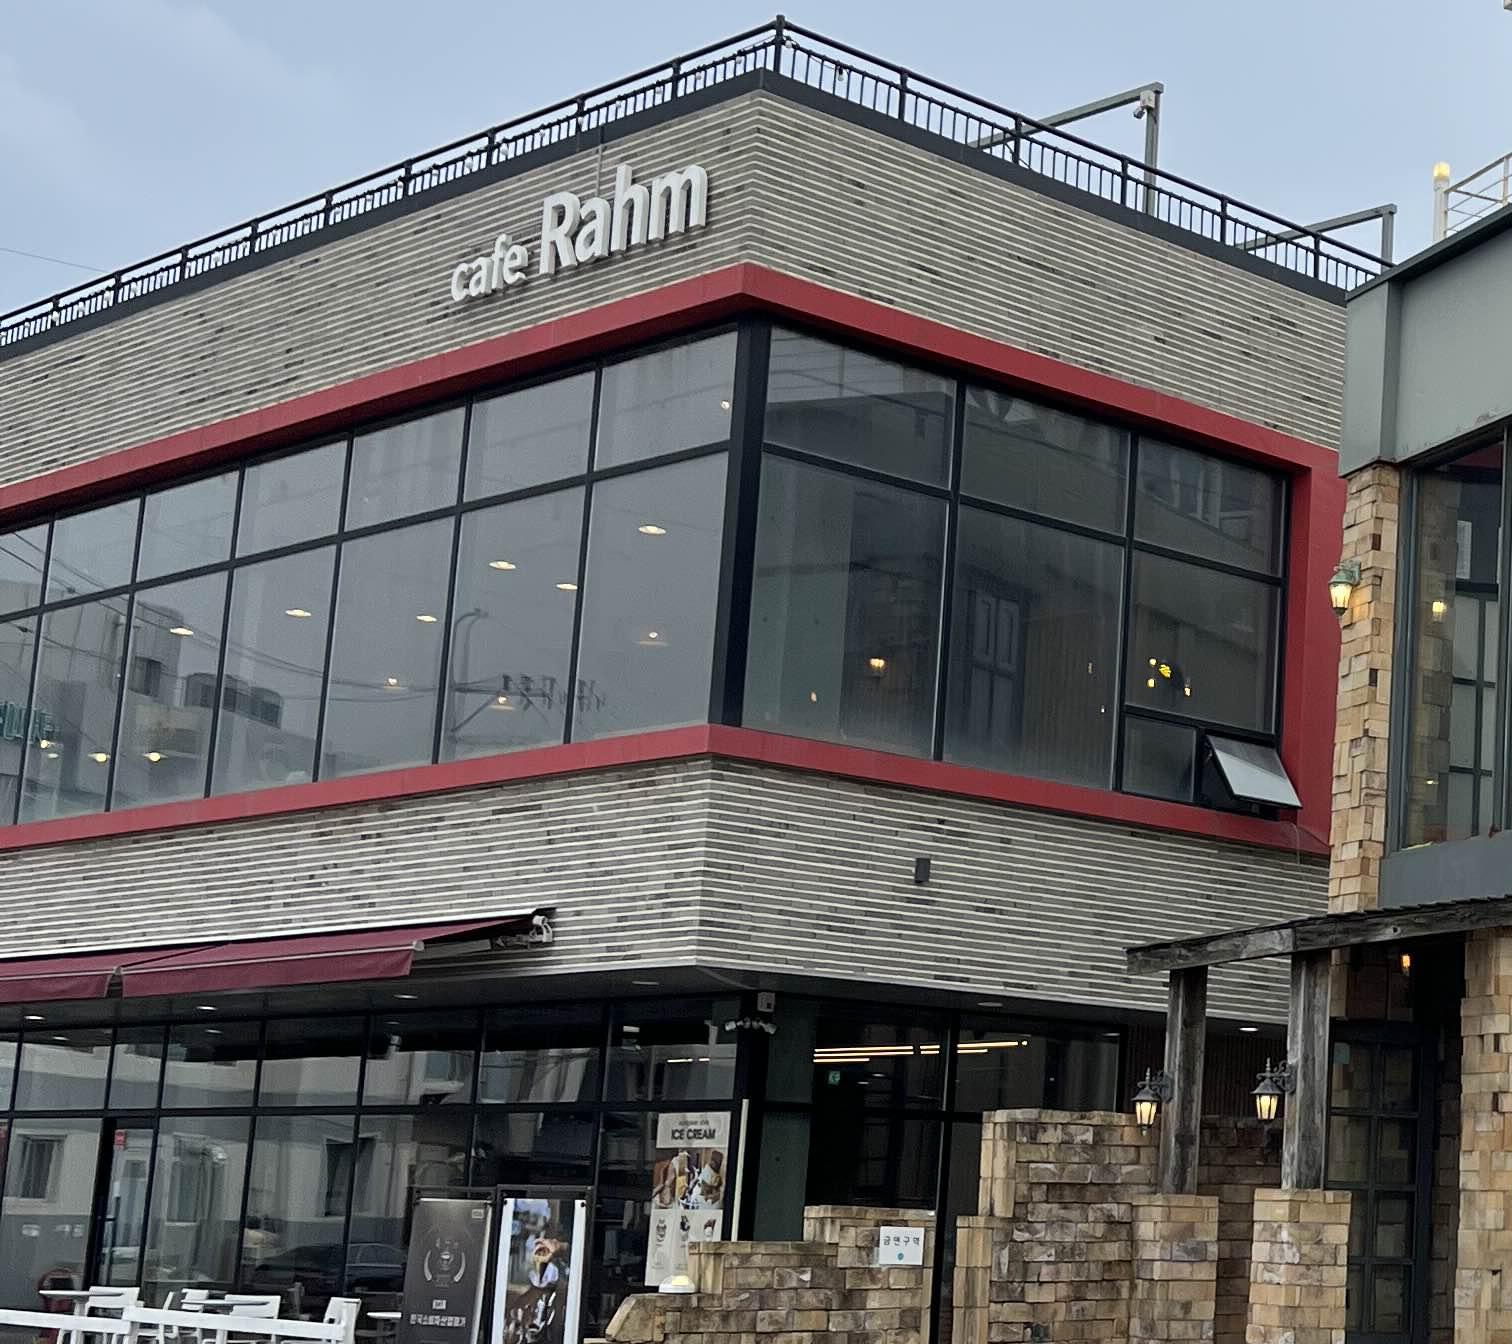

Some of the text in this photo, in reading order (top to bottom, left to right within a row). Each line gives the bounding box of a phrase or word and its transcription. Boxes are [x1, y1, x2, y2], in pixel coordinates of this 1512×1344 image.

[451, 164, 708, 302] cafe Rahm
[671, 1128, 716, 1141] ICE CREAM
[883, 1235, 920, 1247] 금연구역
